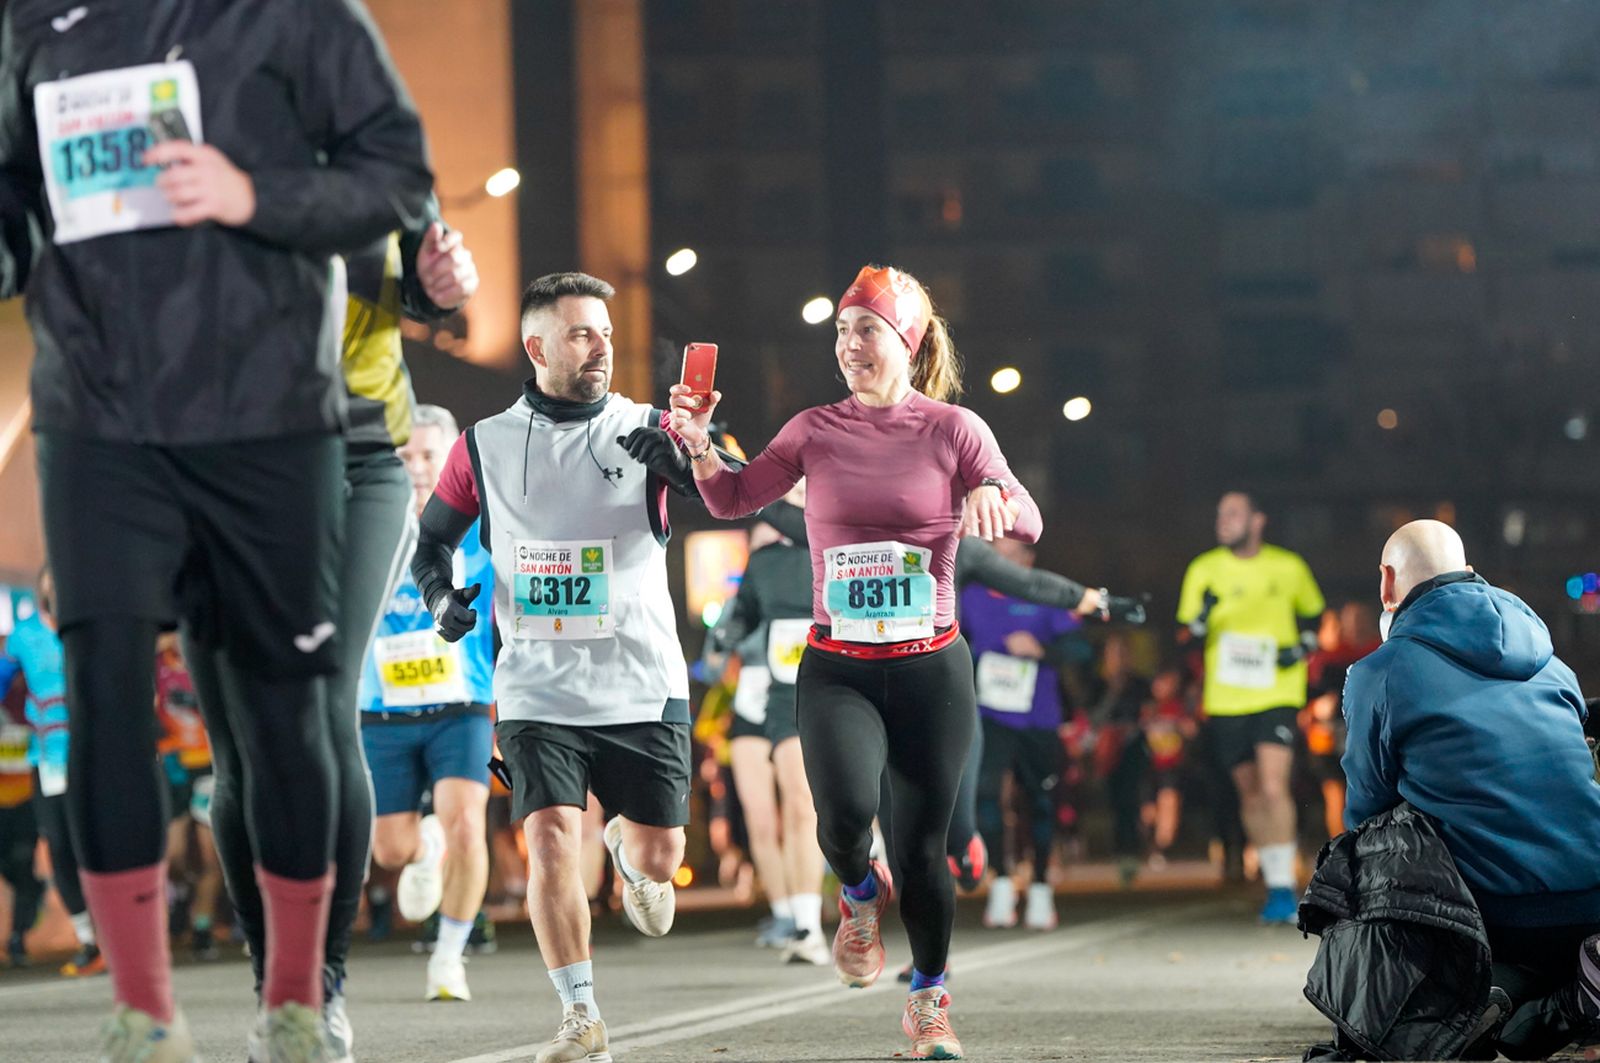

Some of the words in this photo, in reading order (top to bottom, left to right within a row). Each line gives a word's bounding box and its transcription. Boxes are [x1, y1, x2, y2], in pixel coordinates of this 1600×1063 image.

[60, 128, 169, 182] 1358
[529, 552, 557, 562] NOCHE
[559, 552, 572, 562] DE
[848, 553, 878, 564] NOCHE
[881, 552, 893, 562] DE
[520, 563, 537, 574] SAN
[538, 560, 572, 575] ANTÓN
[836, 568, 856, 580] SAN
[858, 563, 894, 577] ANTÓN
[529, 576, 591, 606] 8312
[848, 578, 911, 608] 8311
[393, 658, 445, 680] 5504
